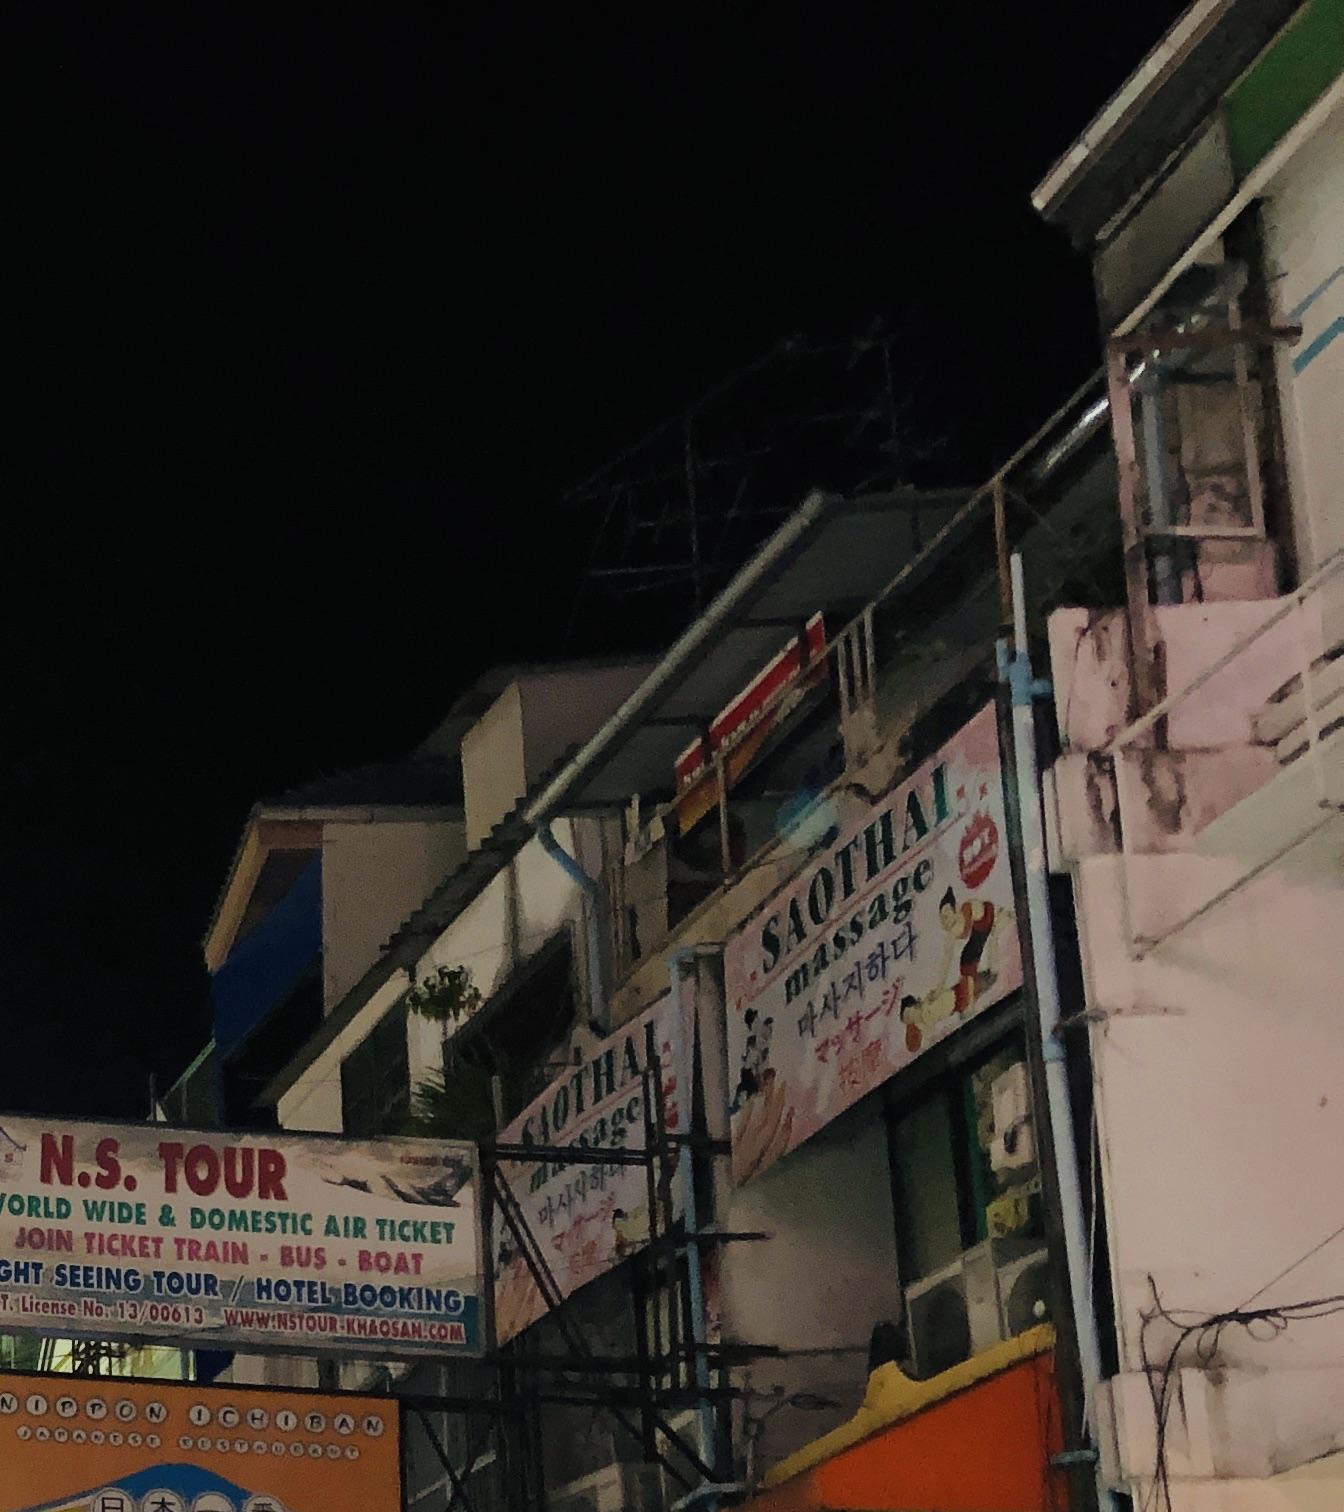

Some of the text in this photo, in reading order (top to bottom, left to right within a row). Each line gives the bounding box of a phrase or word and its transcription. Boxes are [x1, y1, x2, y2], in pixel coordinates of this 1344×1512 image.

[761, 763, 949, 974] SAOTHAI
[784, 858, 935, 1005] massage
[39, 1132, 289, 1200] N.S. TOUR
[84, 1199, 146, 1226] WIDE
[159, 1204, 177, 1228] &
[189, 1207, 314, 1237] DOMESTIC
[324, 1214, 367, 1240] AIR
[375, 1218, 455, 1245] TICKET
[15, 1226, 74, 1253] JOIN
[84, 1231, 162, 1259] TICKET
[173, 1237, 249, 1266] TRAIN
[280, 1246, 327, 1270] BUS
[357, 1249, 424, 1276] BOAT
[20, 1296, 78, 1318] License
[54, 1264, 143, 1293] SEEING
[153, 1270, 221, 1297] TOUR
[255, 1277, 333, 1306] HOTEL
[341, 1283, 464, 1314] BOOKING
[18, 1427, 359, 1459] JAPANESE RESTAURANT
[192, 1406, 381, 1435] ICHIBAN
